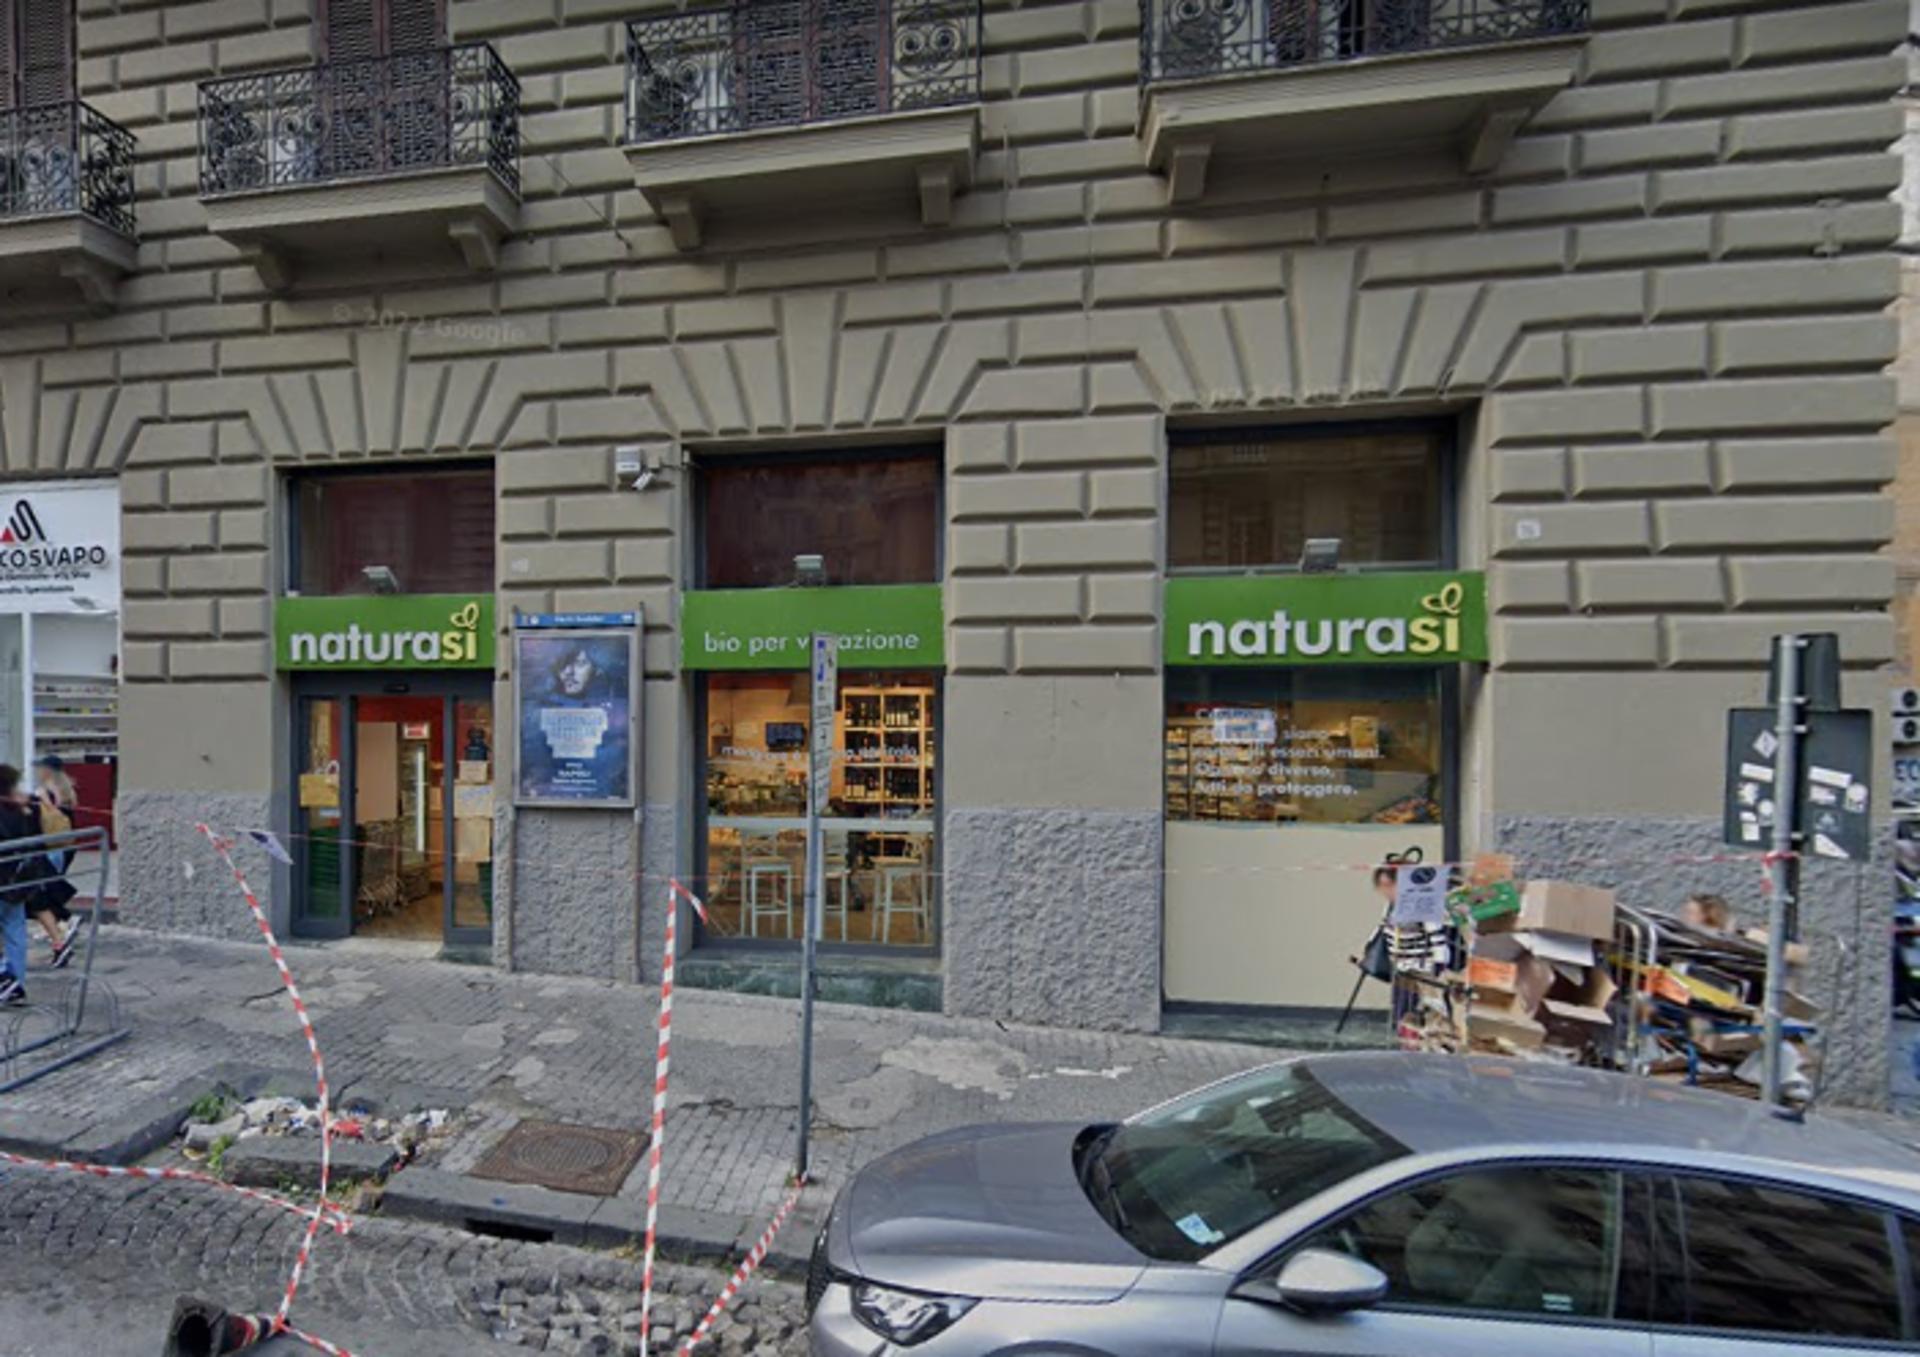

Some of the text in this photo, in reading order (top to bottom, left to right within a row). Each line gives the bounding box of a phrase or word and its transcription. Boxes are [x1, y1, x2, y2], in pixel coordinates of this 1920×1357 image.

[704, 628, 920, 657] bio per vazione
